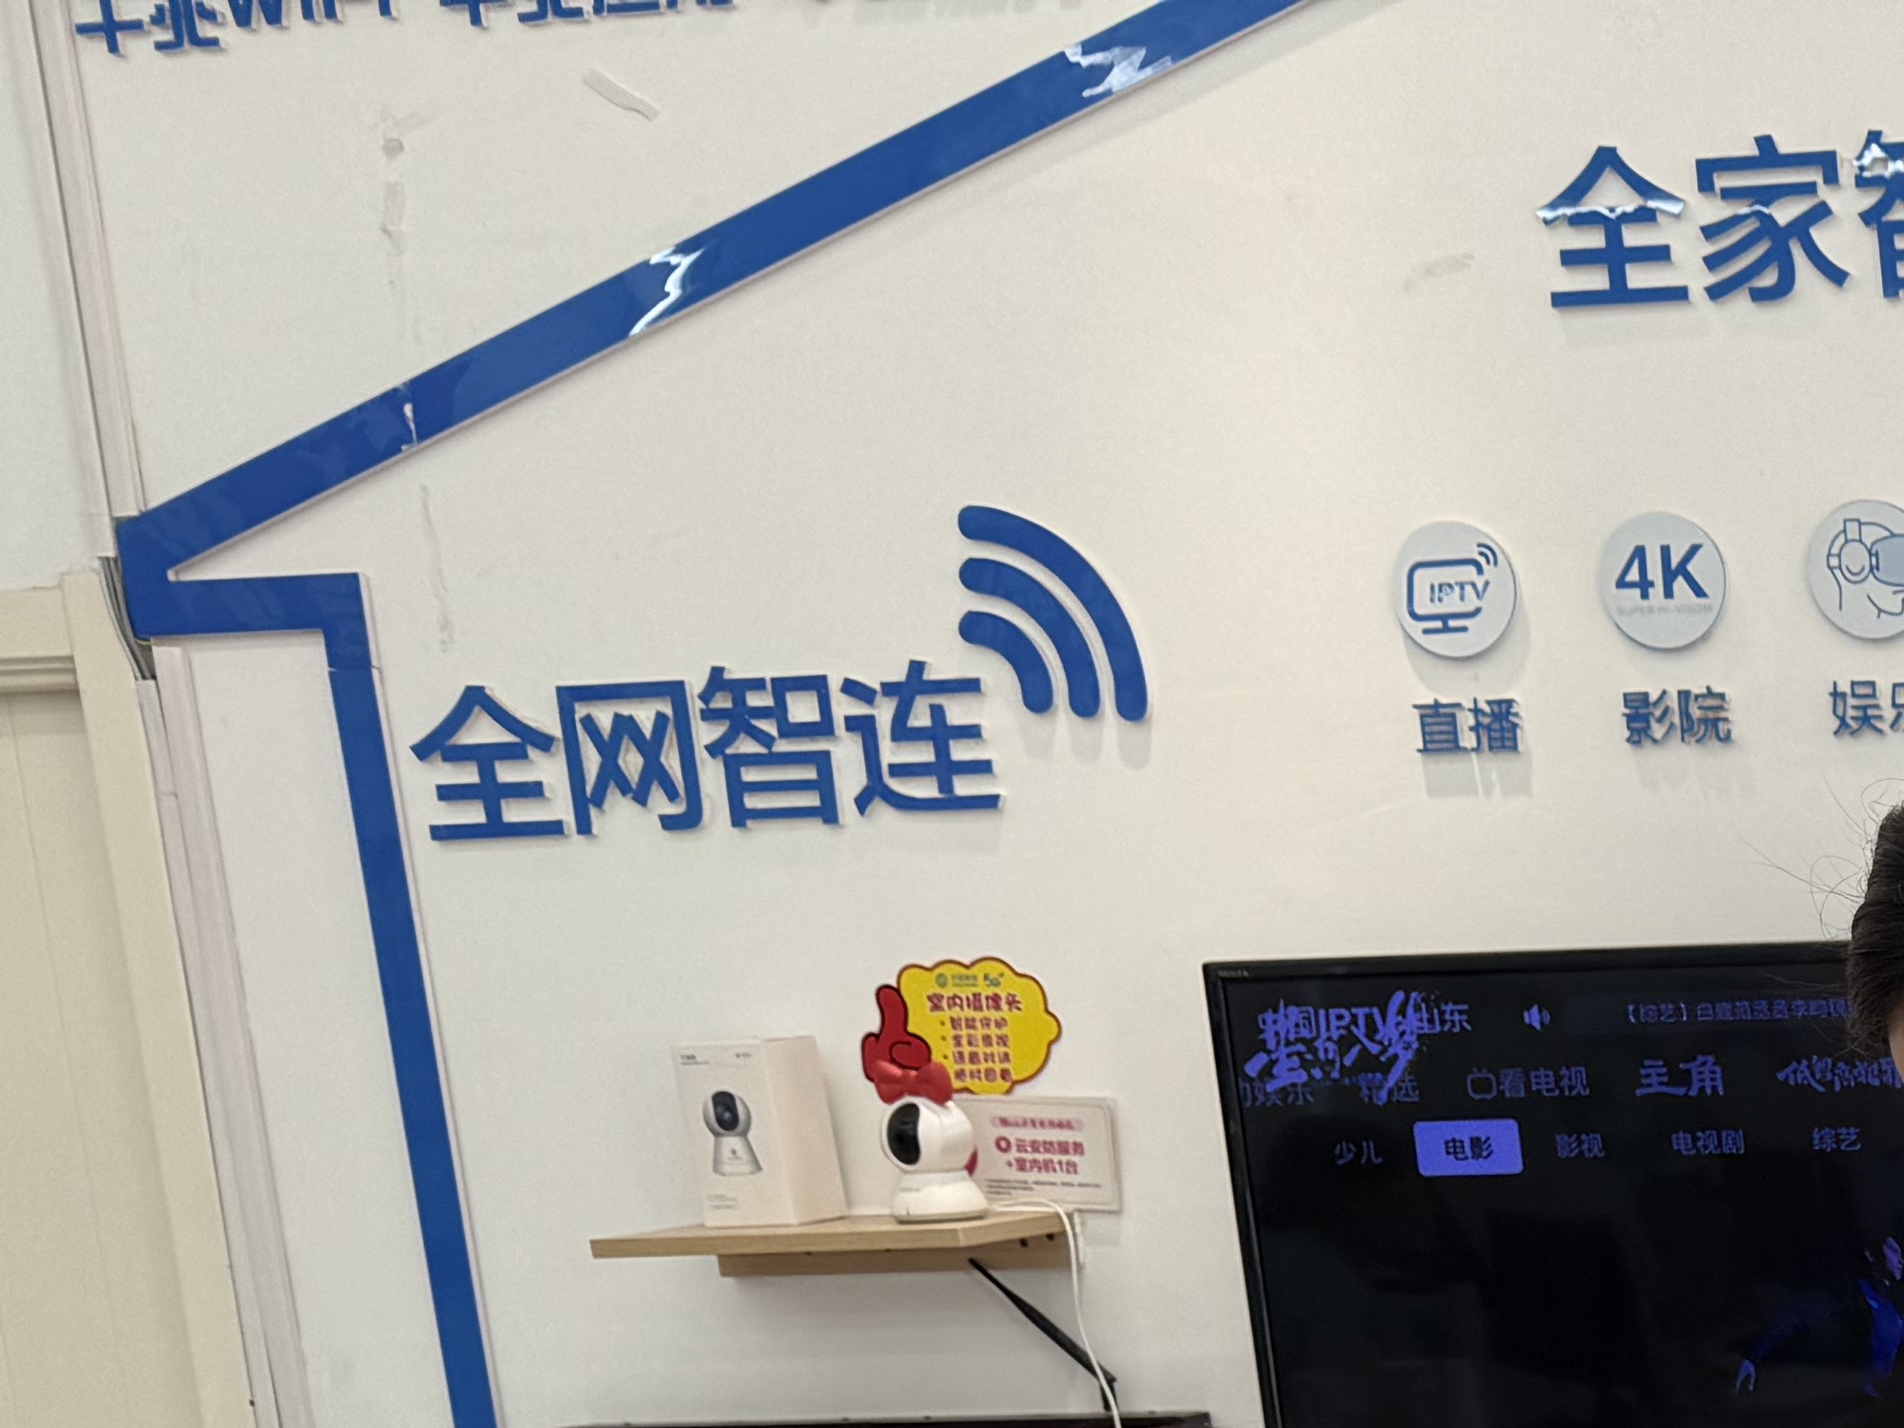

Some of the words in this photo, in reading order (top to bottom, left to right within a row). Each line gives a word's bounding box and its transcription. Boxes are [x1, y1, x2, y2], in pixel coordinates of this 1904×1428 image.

[1615, 543, 1710, 601] 4K
[1415, 698, 1522, 755] 直播
[1620, 687, 1733, 747] 影院
[411, 660, 1001, 840] 全网智连
[1500, 1067, 1589, 1098] 看电视
[1635, 1054, 1724, 1097] 主角
[1335, 1139, 1382, 1166] 少儿
[1443, 1138, 1494, 1161] 电影
[1555, 1132, 1606, 1159] 影视
[1671, 1129, 1745, 1155] 电视剧
[1812, 1127, 1861, 1152] 综艺
